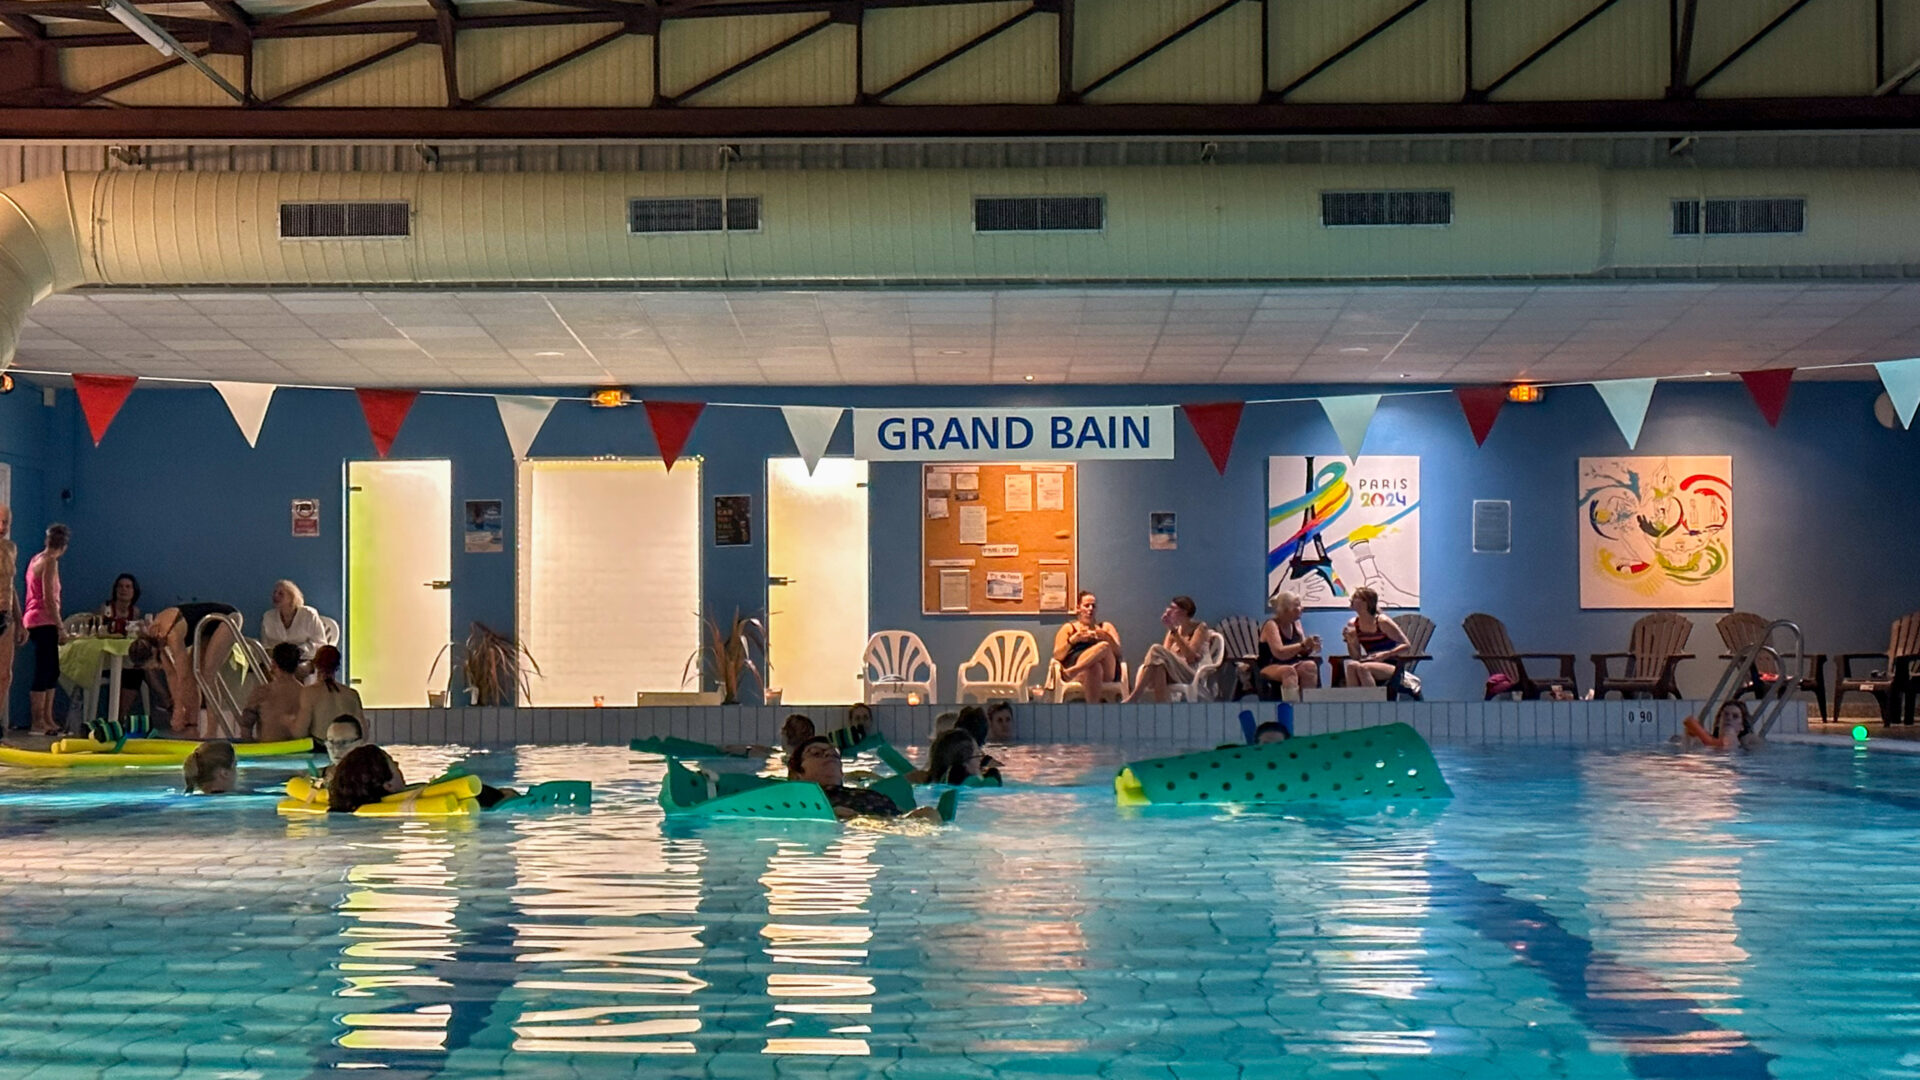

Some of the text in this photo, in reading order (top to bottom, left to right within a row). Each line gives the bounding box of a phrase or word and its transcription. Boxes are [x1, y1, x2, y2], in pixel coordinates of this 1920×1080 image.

[877, 415, 1150, 451] GRAND BAIN
[1359, 478, 1408, 490] PARIS
[1360, 491, 1407, 507] 2024
[1639, 711, 1653, 724] 90
